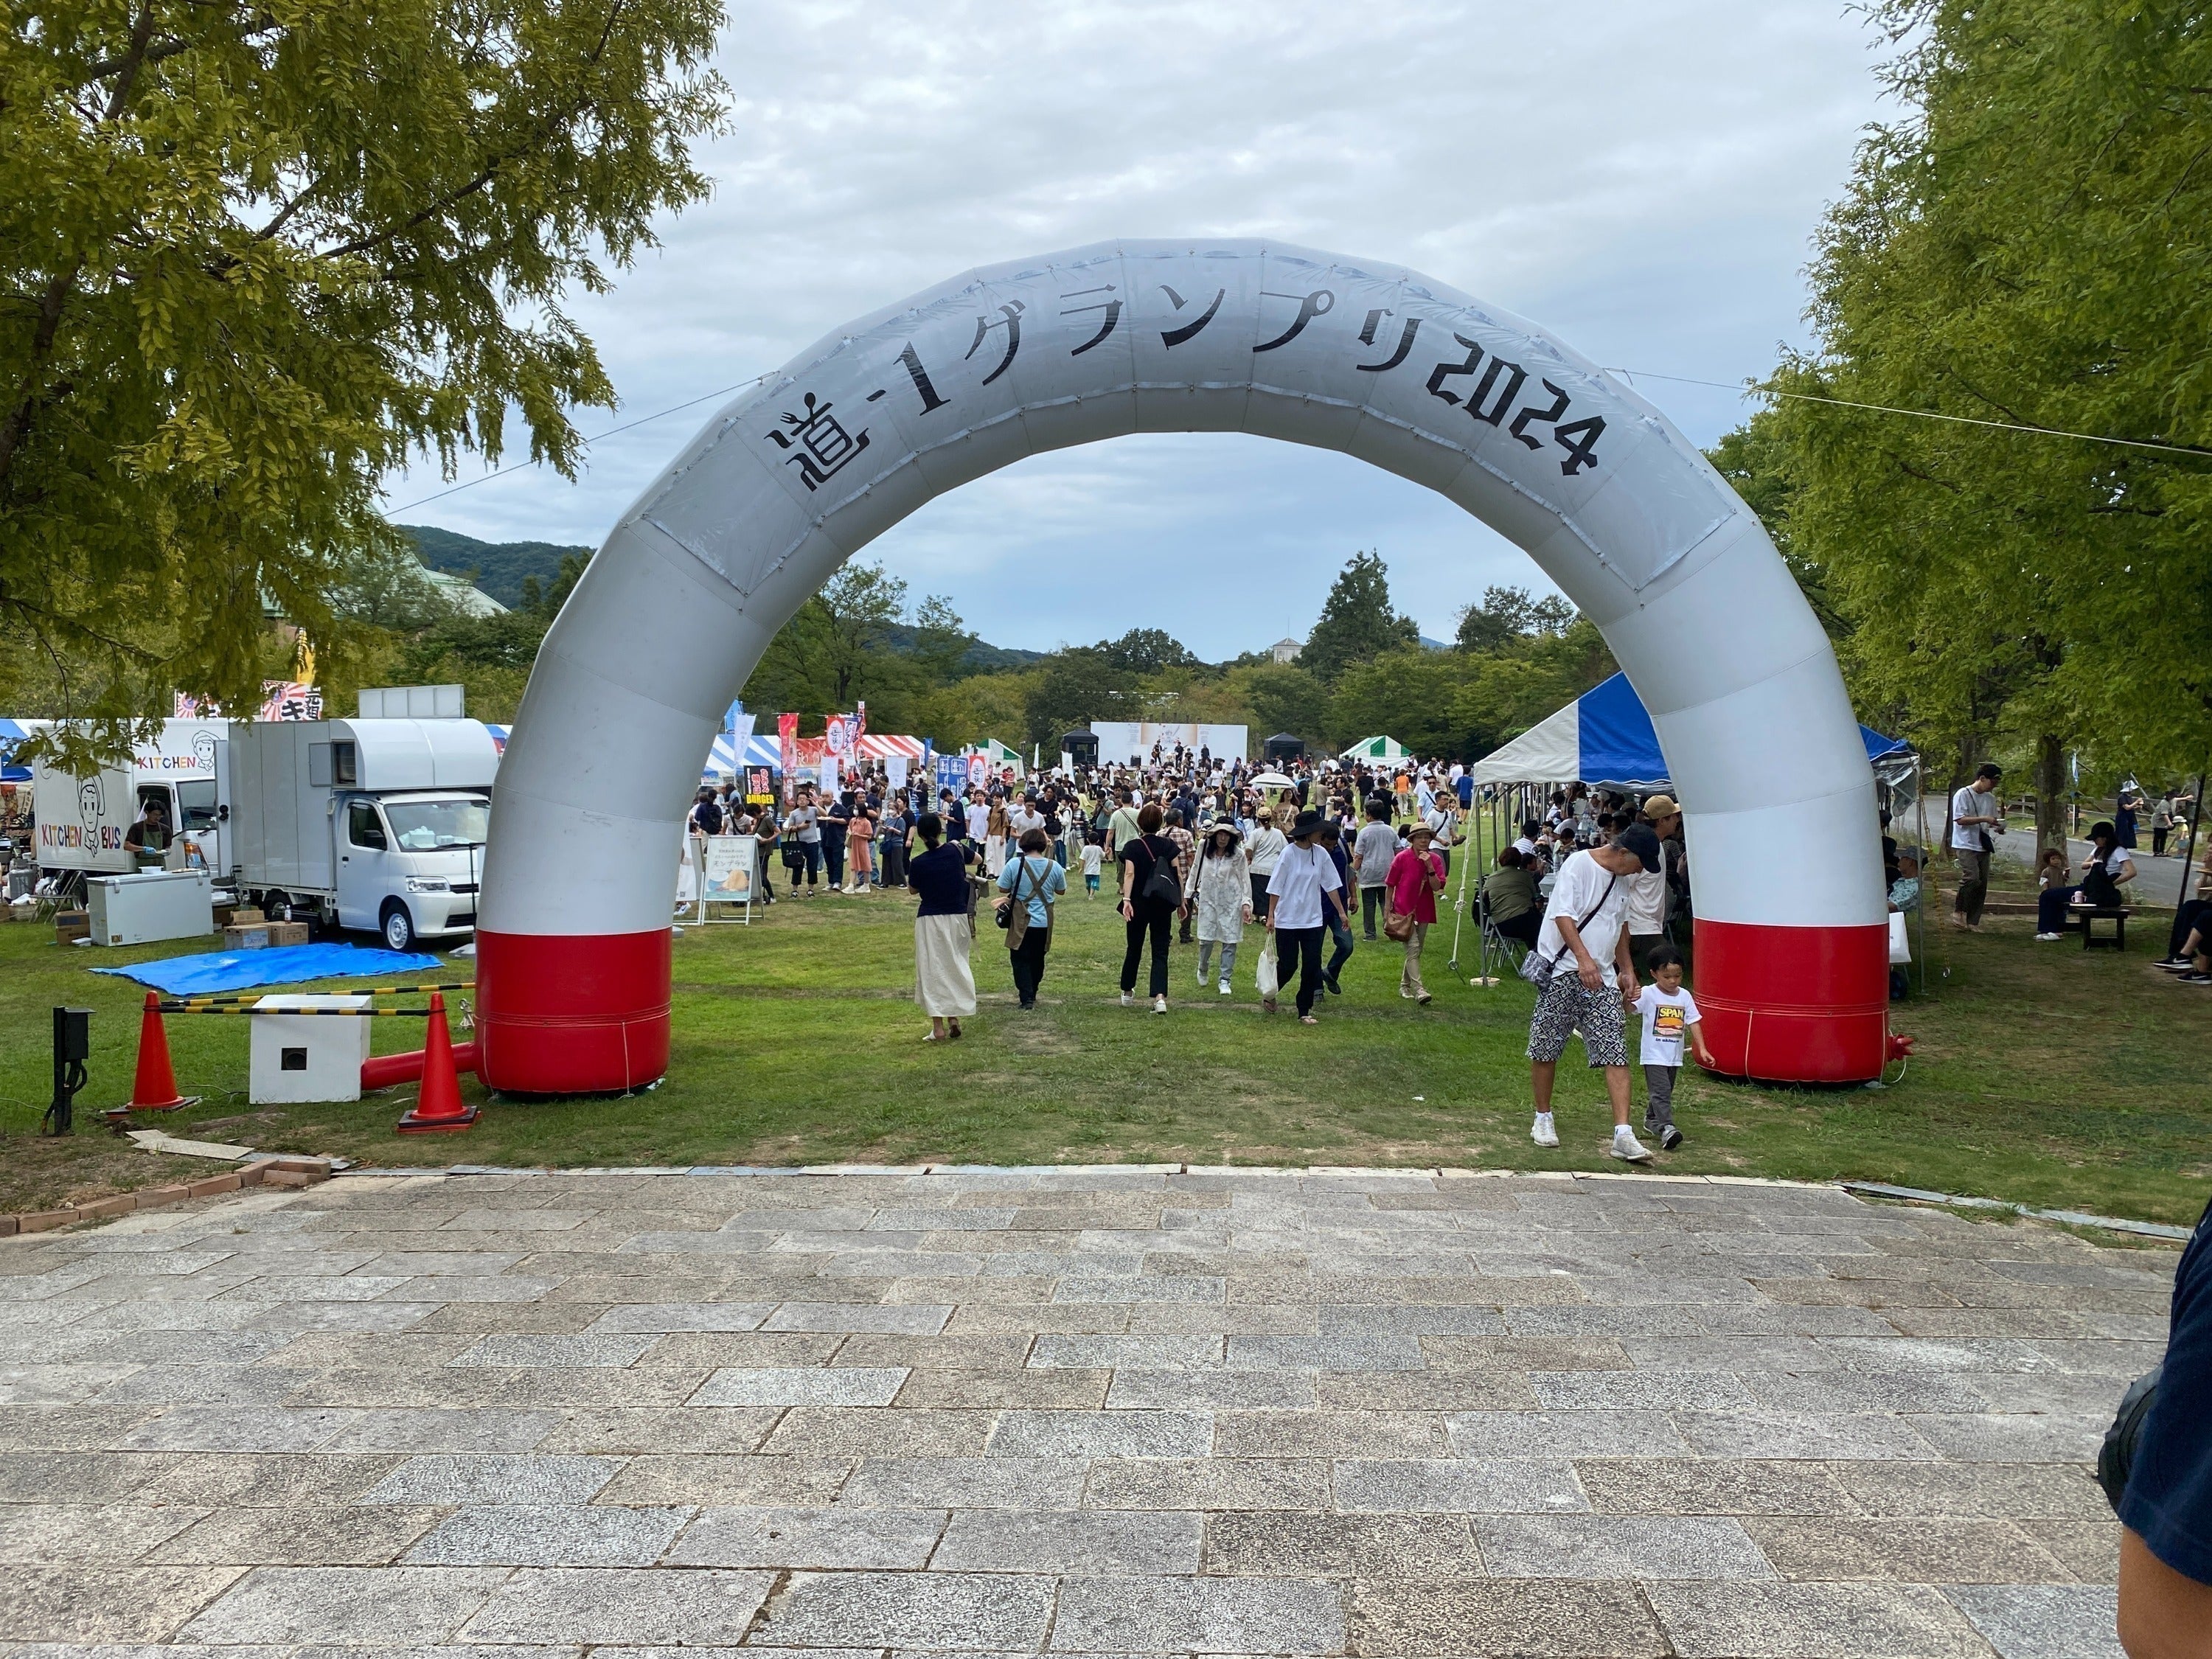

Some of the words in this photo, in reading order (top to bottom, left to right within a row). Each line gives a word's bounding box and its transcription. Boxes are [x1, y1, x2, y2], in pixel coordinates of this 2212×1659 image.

[305, 691, 320, 718] 元祖
[139, 757, 196, 769] KITCHEN
[746, 794, 774, 804] BURGER
[41, 824, 82, 847] KITCHEN
[101, 826, 121, 849] BUS
